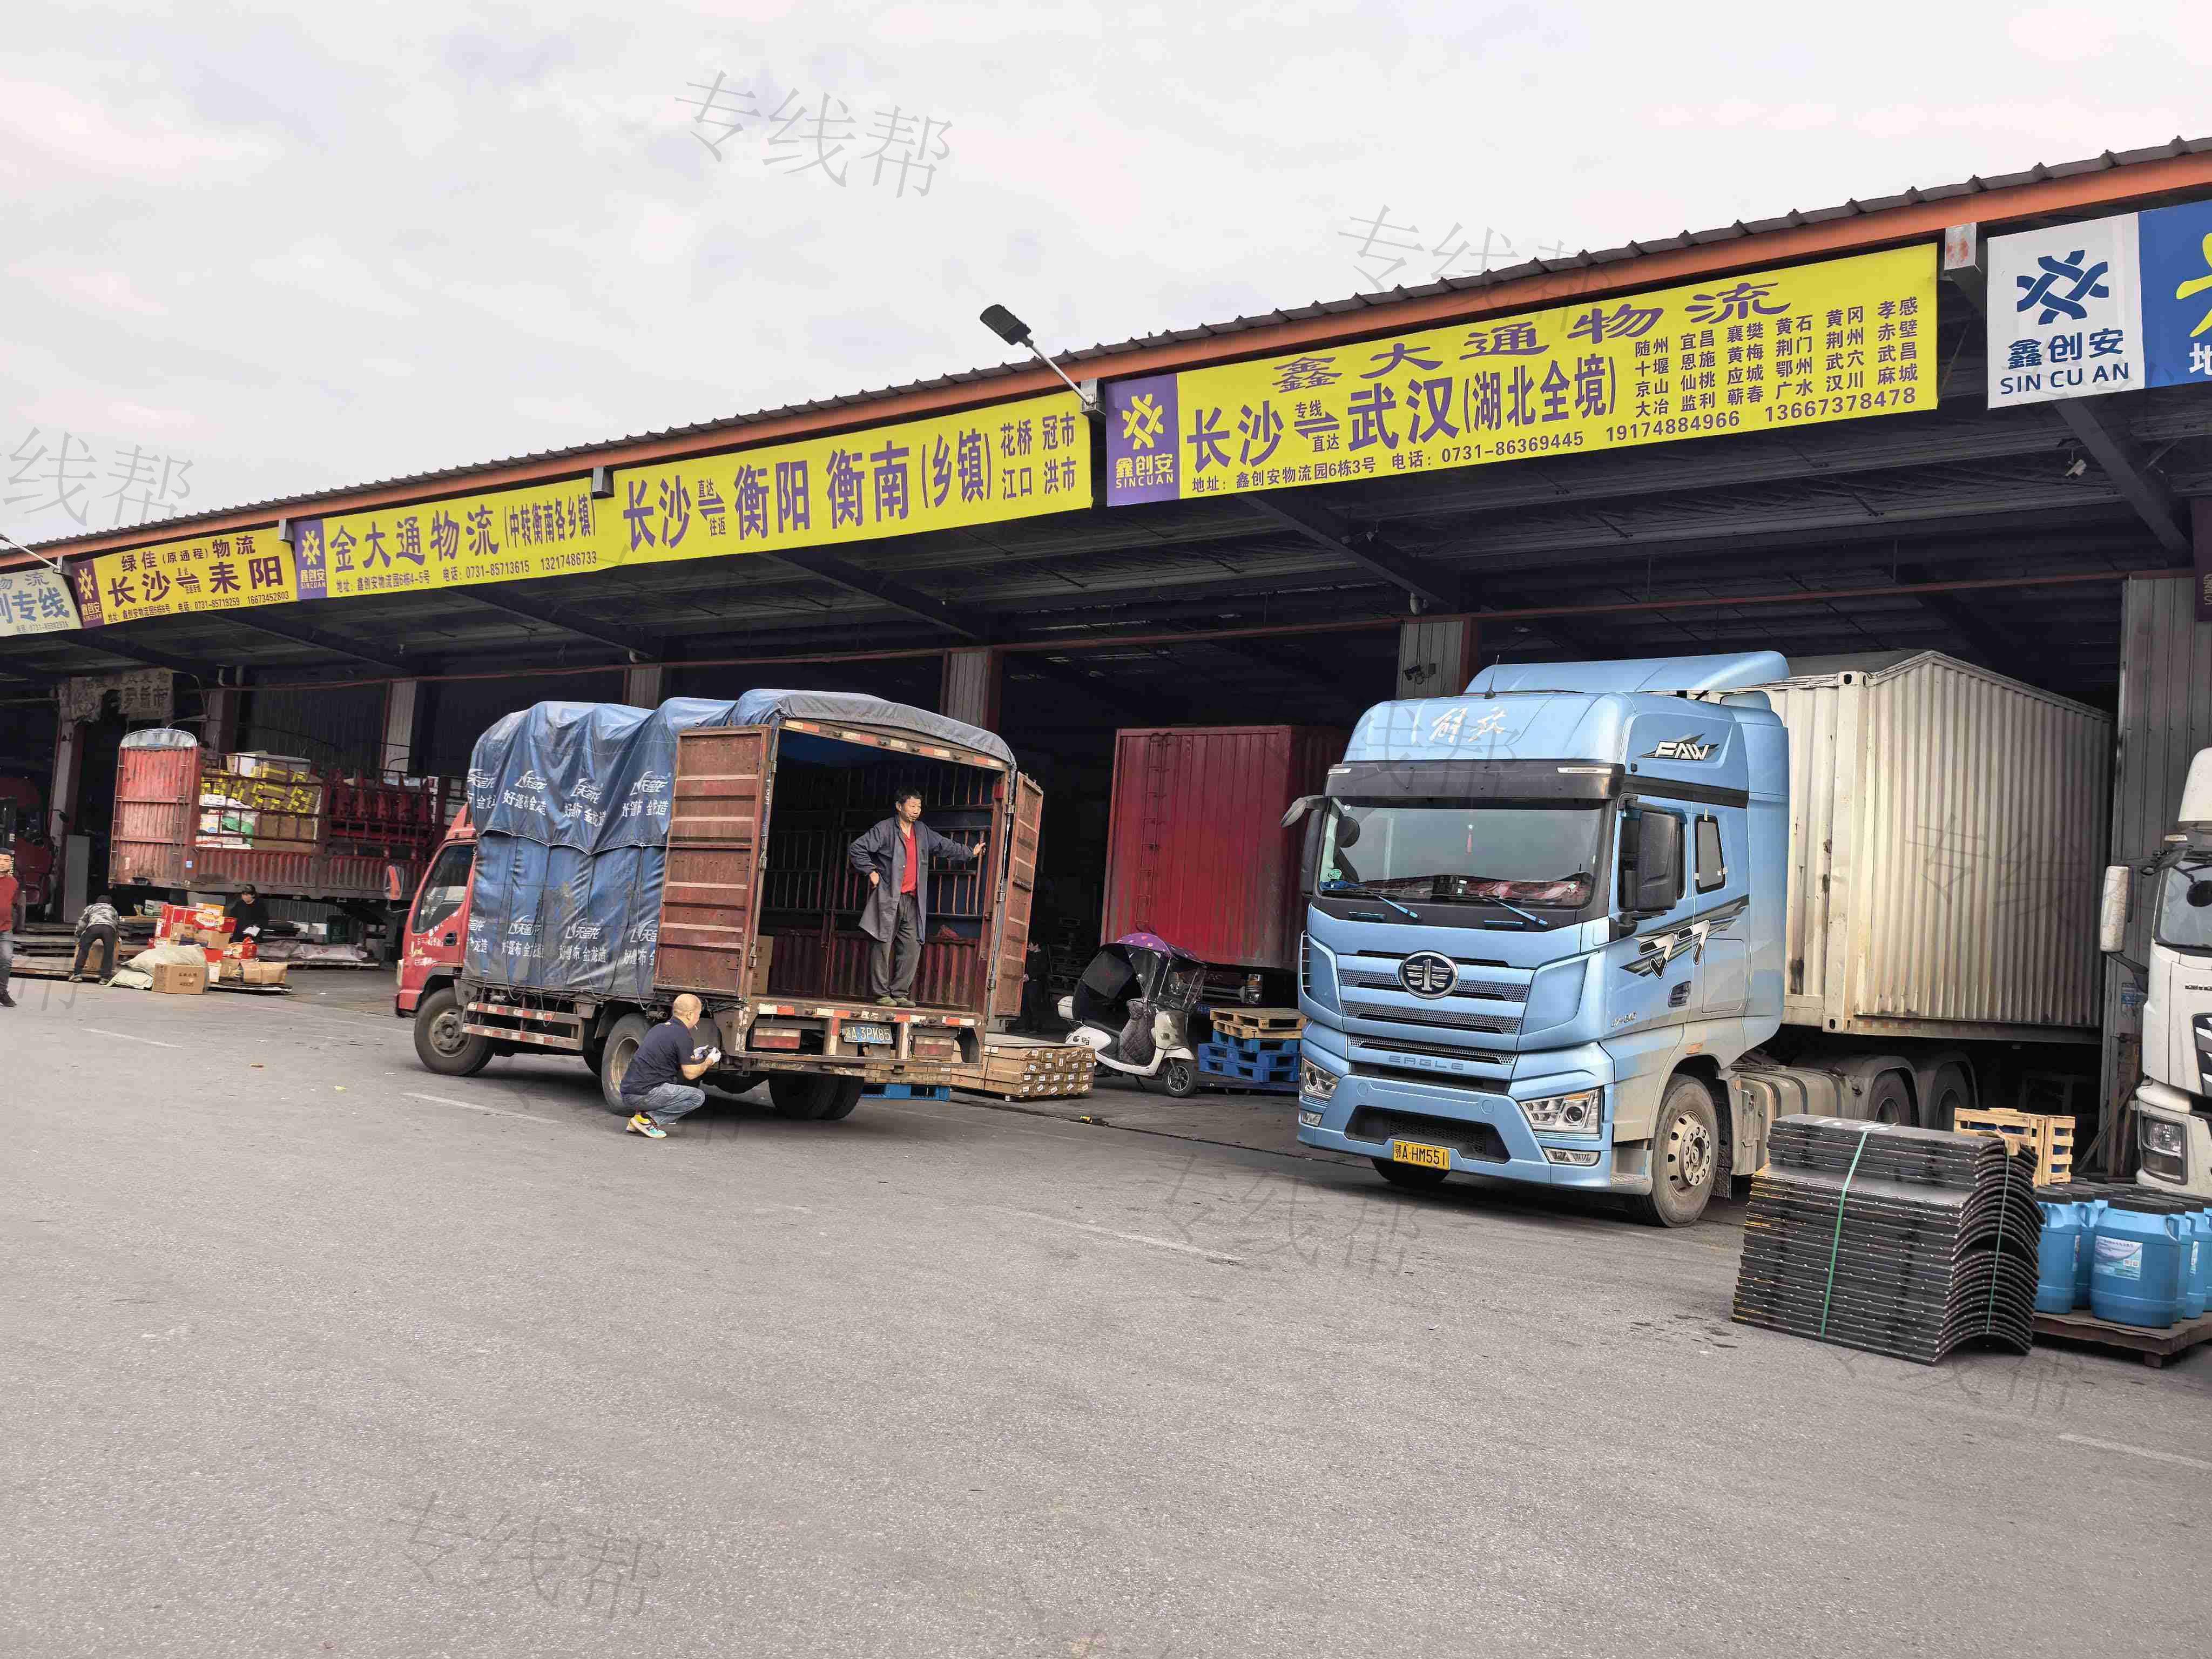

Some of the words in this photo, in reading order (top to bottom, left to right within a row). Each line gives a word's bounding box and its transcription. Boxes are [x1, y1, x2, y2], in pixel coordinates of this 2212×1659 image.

[1272, 282, 1791, 393] 鑫大通物流
[1635, 336, 1668, 357] 随州
[1681, 329, 1714, 350] 宜昌
[1776, 314, 1813, 336] 黄石
[1826, 306, 1863, 328] 黄冈
[1878, 296, 1918, 319] 孝感
[1635, 358, 1669, 377] 十堰
[1681, 350, 1715, 370] 恩施
[1727, 343, 1764, 364] 黄梅
[1776, 336, 1812, 357] 荆门
[1826, 327, 1864, 349] 荆州
[1878, 319, 1918, 341] 赤壁
[2008, 328, 2124, 369] 鑫创安
[1635, 378, 1668, 397] 京山
[1681, 371, 1715, 391] 仙桃
[1727, 364, 1764, 385] 应城
[1776, 357, 1812, 377] 鄂州
[1826, 349, 1864, 370] 武穴
[1878, 341, 1917, 363] 武昌
[1635, 399, 1669, 418] 大冶
[1681, 392, 1715, 412] 监利
[1727, 385, 1763, 405] 蕲春
[1776, 379, 1813, 399] 广水
[1826, 371, 1864, 392] 汉川
[1878, 363, 1918, 385] 麻城
[1294, 400, 1323, 419] 专线
[1606, 411, 1740, 442] 19174884966
[1765, 387, 1916, 423] 13667378478
[1000, 419, 1032, 458] 花桥
[1042, 412, 1076, 450] 冠市
[1188, 400, 1284, 473] 长沙
[1312, 434, 1340, 453] 直达
[697, 478, 714, 498] 直达
[1002, 467, 1033, 500] 江口
[1043, 456, 1076, 495] 洪市
[1116, 453, 1174, 478] 鑫创安
[1116, 473, 1174, 489] SINCUAN
[623, 475, 692, 552] 长沙
[710, 517, 726, 536] 往返
[108, 570, 171, 608] 长沙
[209, 556, 284, 594] 耒阳
[1654, 740, 1710, 761] FAW
[1388, 1055, 1465, 1071] EAGLE
